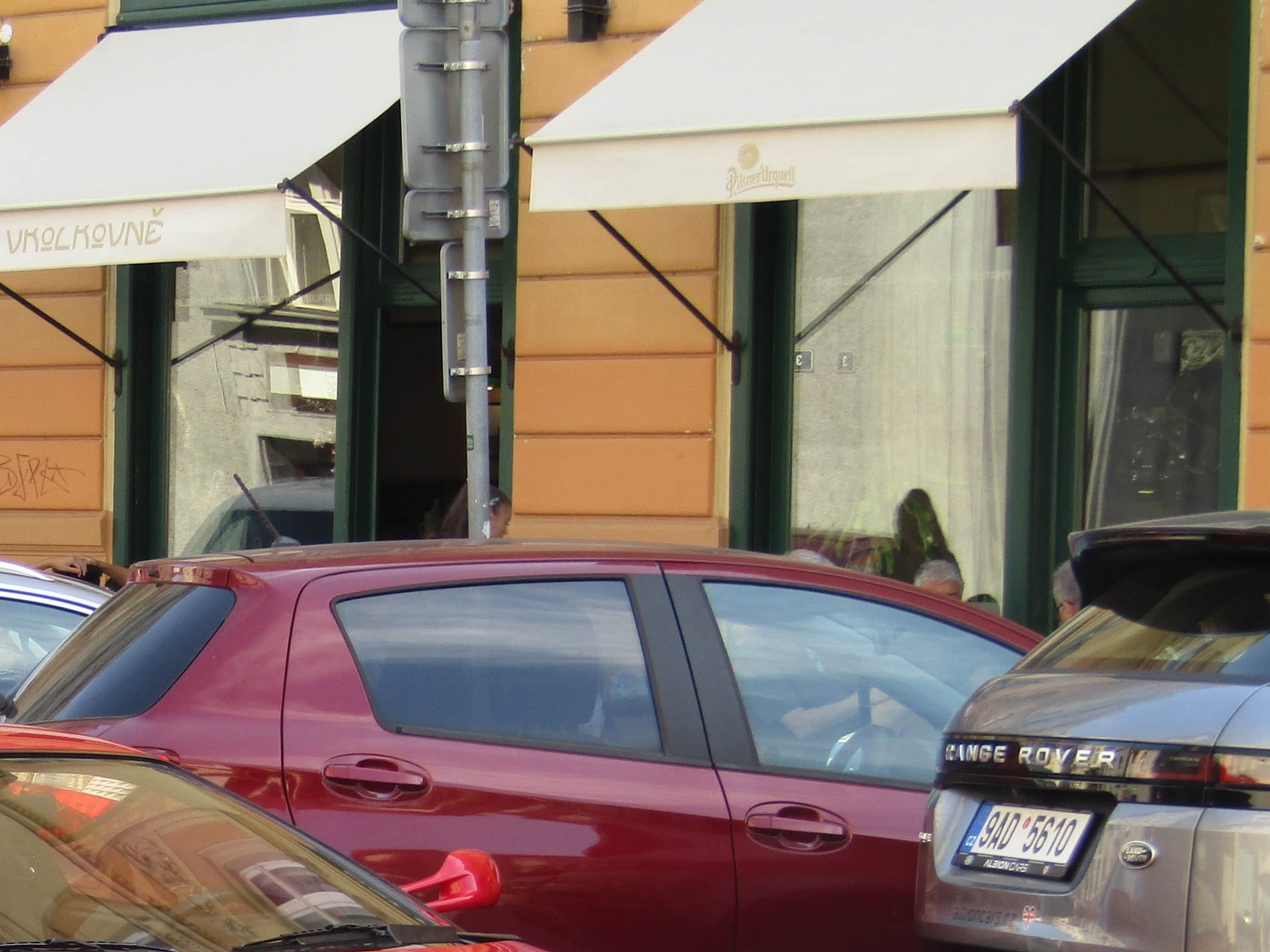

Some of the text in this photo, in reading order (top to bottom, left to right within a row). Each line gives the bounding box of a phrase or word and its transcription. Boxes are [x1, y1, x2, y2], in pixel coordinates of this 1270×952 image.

[6, 207, 165, 254] VKOLKOVNĚ
[944, 743, 1117, 770] RANGE ROVER
[964, 835, 977, 846] CZ
[979, 810, 1078, 857] 9AD 5610
